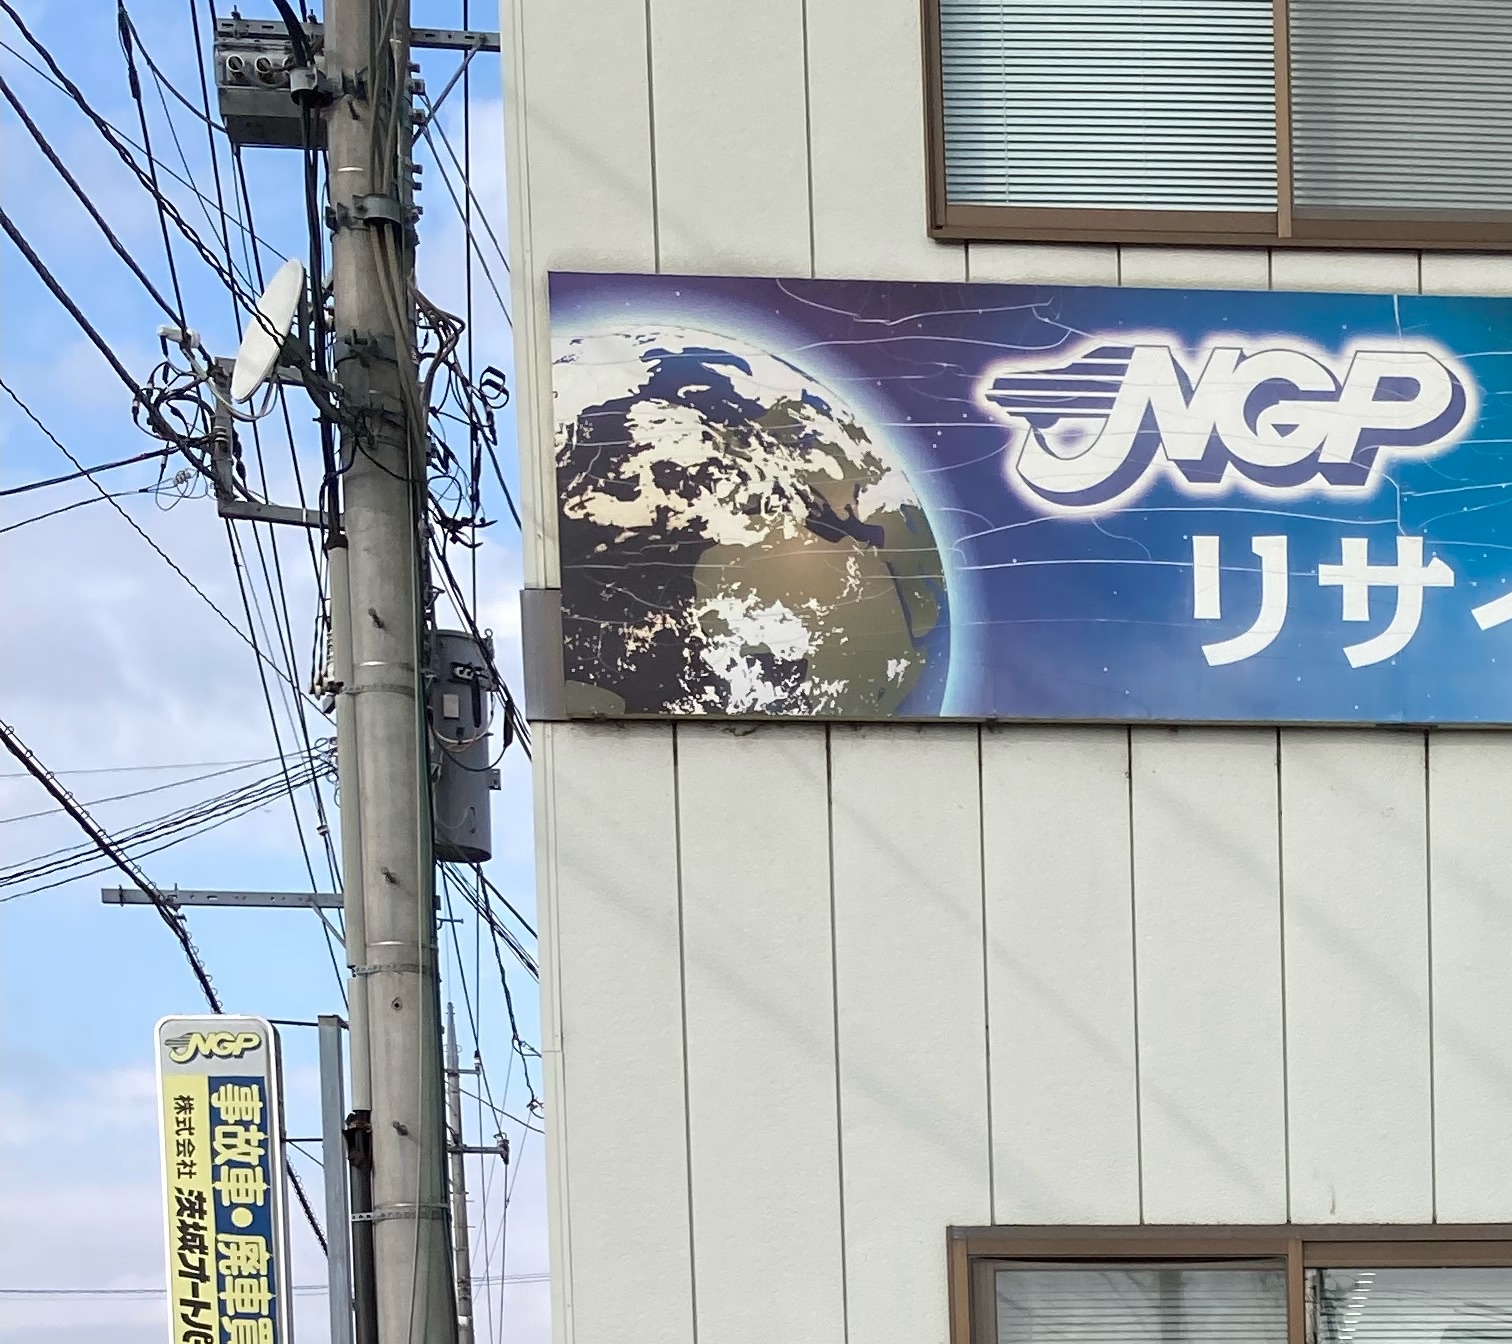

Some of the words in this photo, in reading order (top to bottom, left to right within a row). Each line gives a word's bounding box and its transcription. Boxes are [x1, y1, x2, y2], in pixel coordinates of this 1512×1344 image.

[985, 345, 1467, 507] NGP
[165, 1031, 261, 1064] NGP
[174, 1094, 197, 1179] 株式会社
